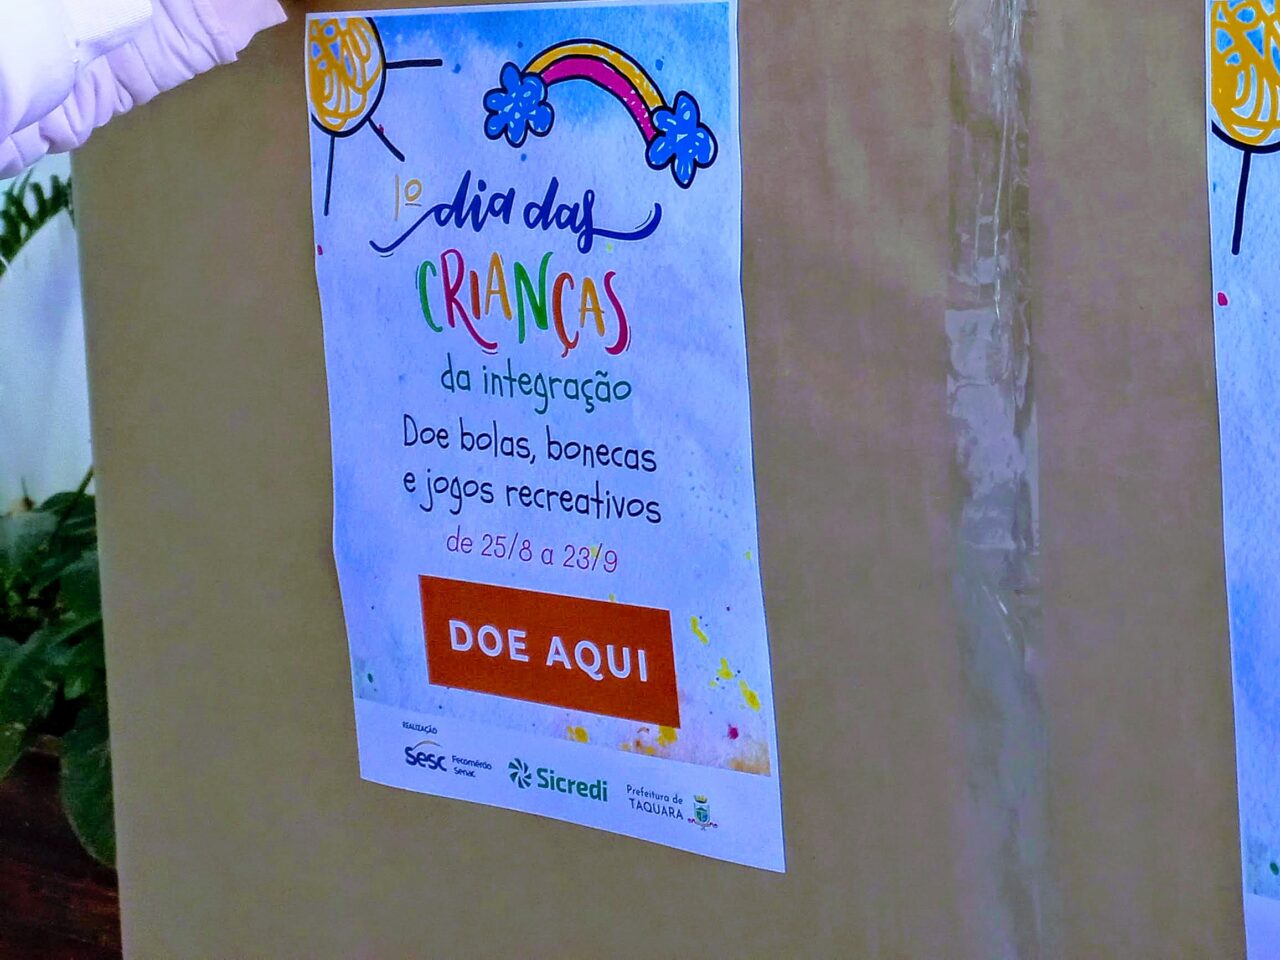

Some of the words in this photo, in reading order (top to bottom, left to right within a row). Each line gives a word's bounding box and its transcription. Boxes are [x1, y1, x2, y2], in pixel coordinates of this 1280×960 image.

[523, 177, 662, 253] das
[415, 248, 631, 357] CRIANÇAS
[440, 352, 471, 393] da
[483, 357, 632, 414] integração
[402, 413, 449, 450] Doe
[460, 417, 536, 465] bolas,
[546, 425, 658, 473] bonecas
[403, 470, 417, 493] e
[419, 468, 494, 515] jogos
[506, 480, 662, 524] recreativos
[446, 525, 472, 555] de
[481, 532, 532, 563] 25/8
[541, 545, 554, 565] a
[563, 543, 618, 573] 23/9
[448, 619, 529, 663] DOE
[546, 637, 648, 682] AQUI
[404, 743, 448, 772] Sesc
[536, 767, 608, 802] Sicredi
[626, 784, 670, 803] Prefeitura
[672, 793, 684, 805] de
[629, 797, 684, 820] TAQUARA
